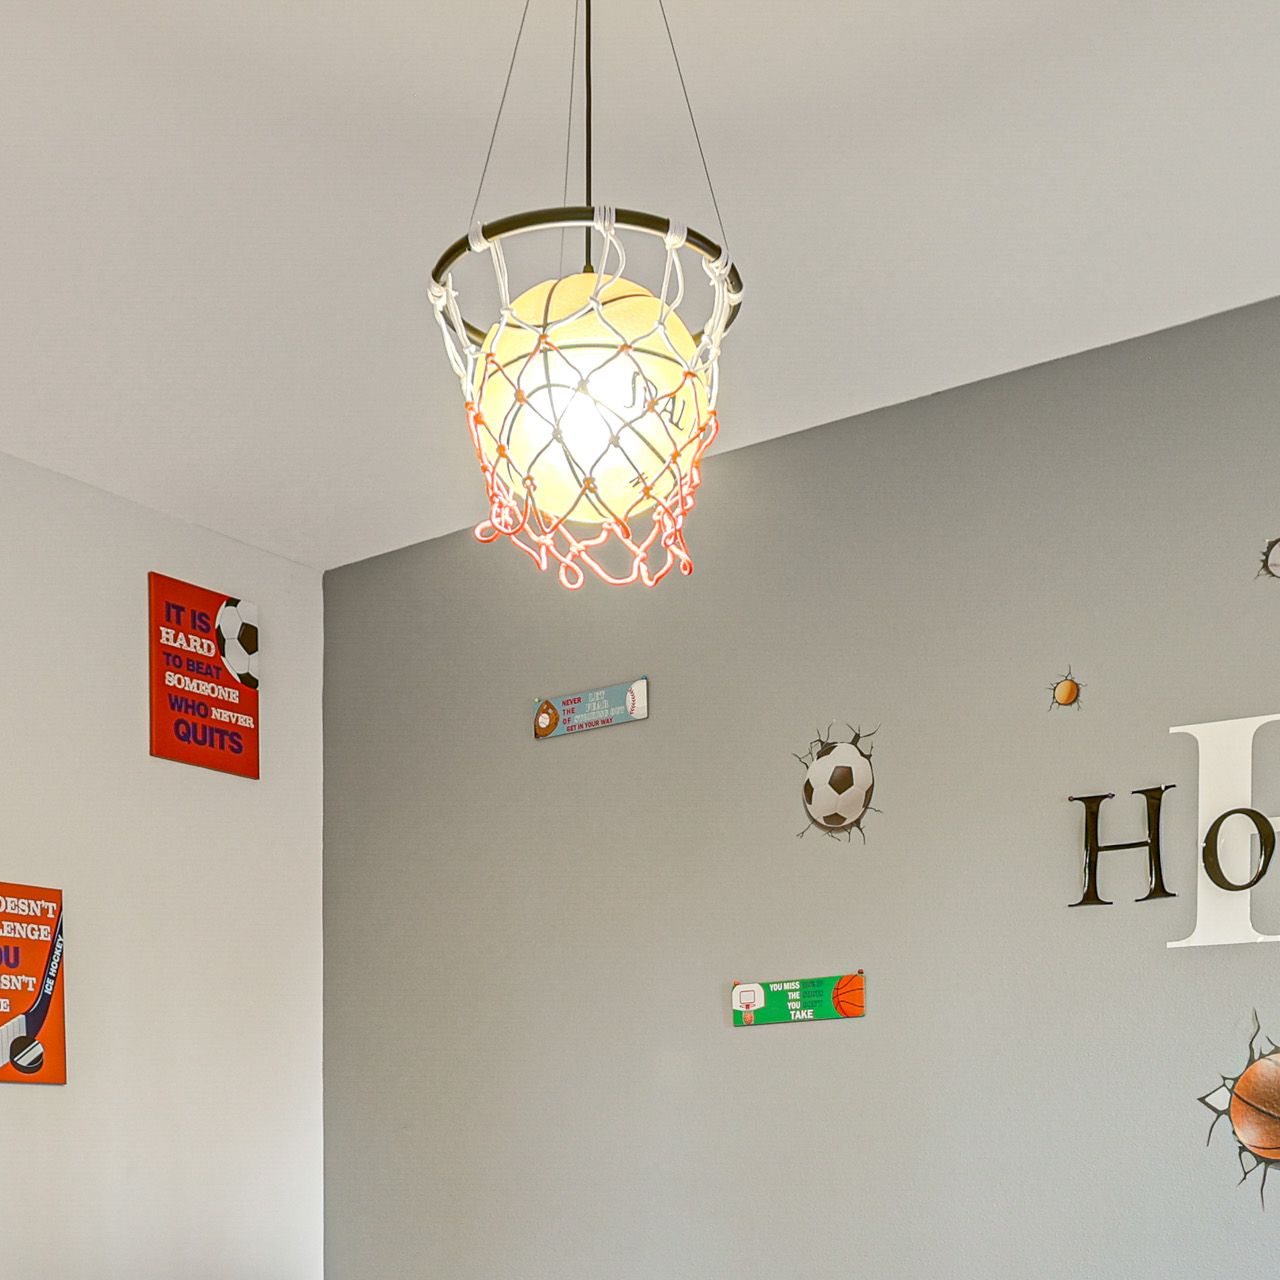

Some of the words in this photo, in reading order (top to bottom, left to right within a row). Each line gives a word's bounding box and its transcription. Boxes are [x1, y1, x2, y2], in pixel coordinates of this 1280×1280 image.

[164, 600, 186, 626] IT
[191, 609, 211, 634] IS
[159, 626, 216, 657] HARD
[162, 651, 183, 669] TO
[186, 658, 222, 680] BEAT
[164, 671, 240, 704] SOMEONE
[562, 697, 582, 706] NEVER
[168, 693, 209, 717] WHO
[211, 707, 255, 729] NEVER
[563, 707, 575, 715] THE
[562, 717, 572, 725] OF
[566, 724, 577, 732] GET
[585, 719, 600, 728] YOUR
[600, 716, 613, 725] WAY
[174, 718, 244, 755] QUITS
[49, 934, 65, 978] HOCKEY
[44, 978, 55, 995] ICE
[769, 983, 783, 992] YOU
[783, 981, 800, 990] MISS
[787, 991, 800, 1000] THE
[787, 1000, 800, 1010] YOU
[790, 1009, 814, 1020] TAKE
